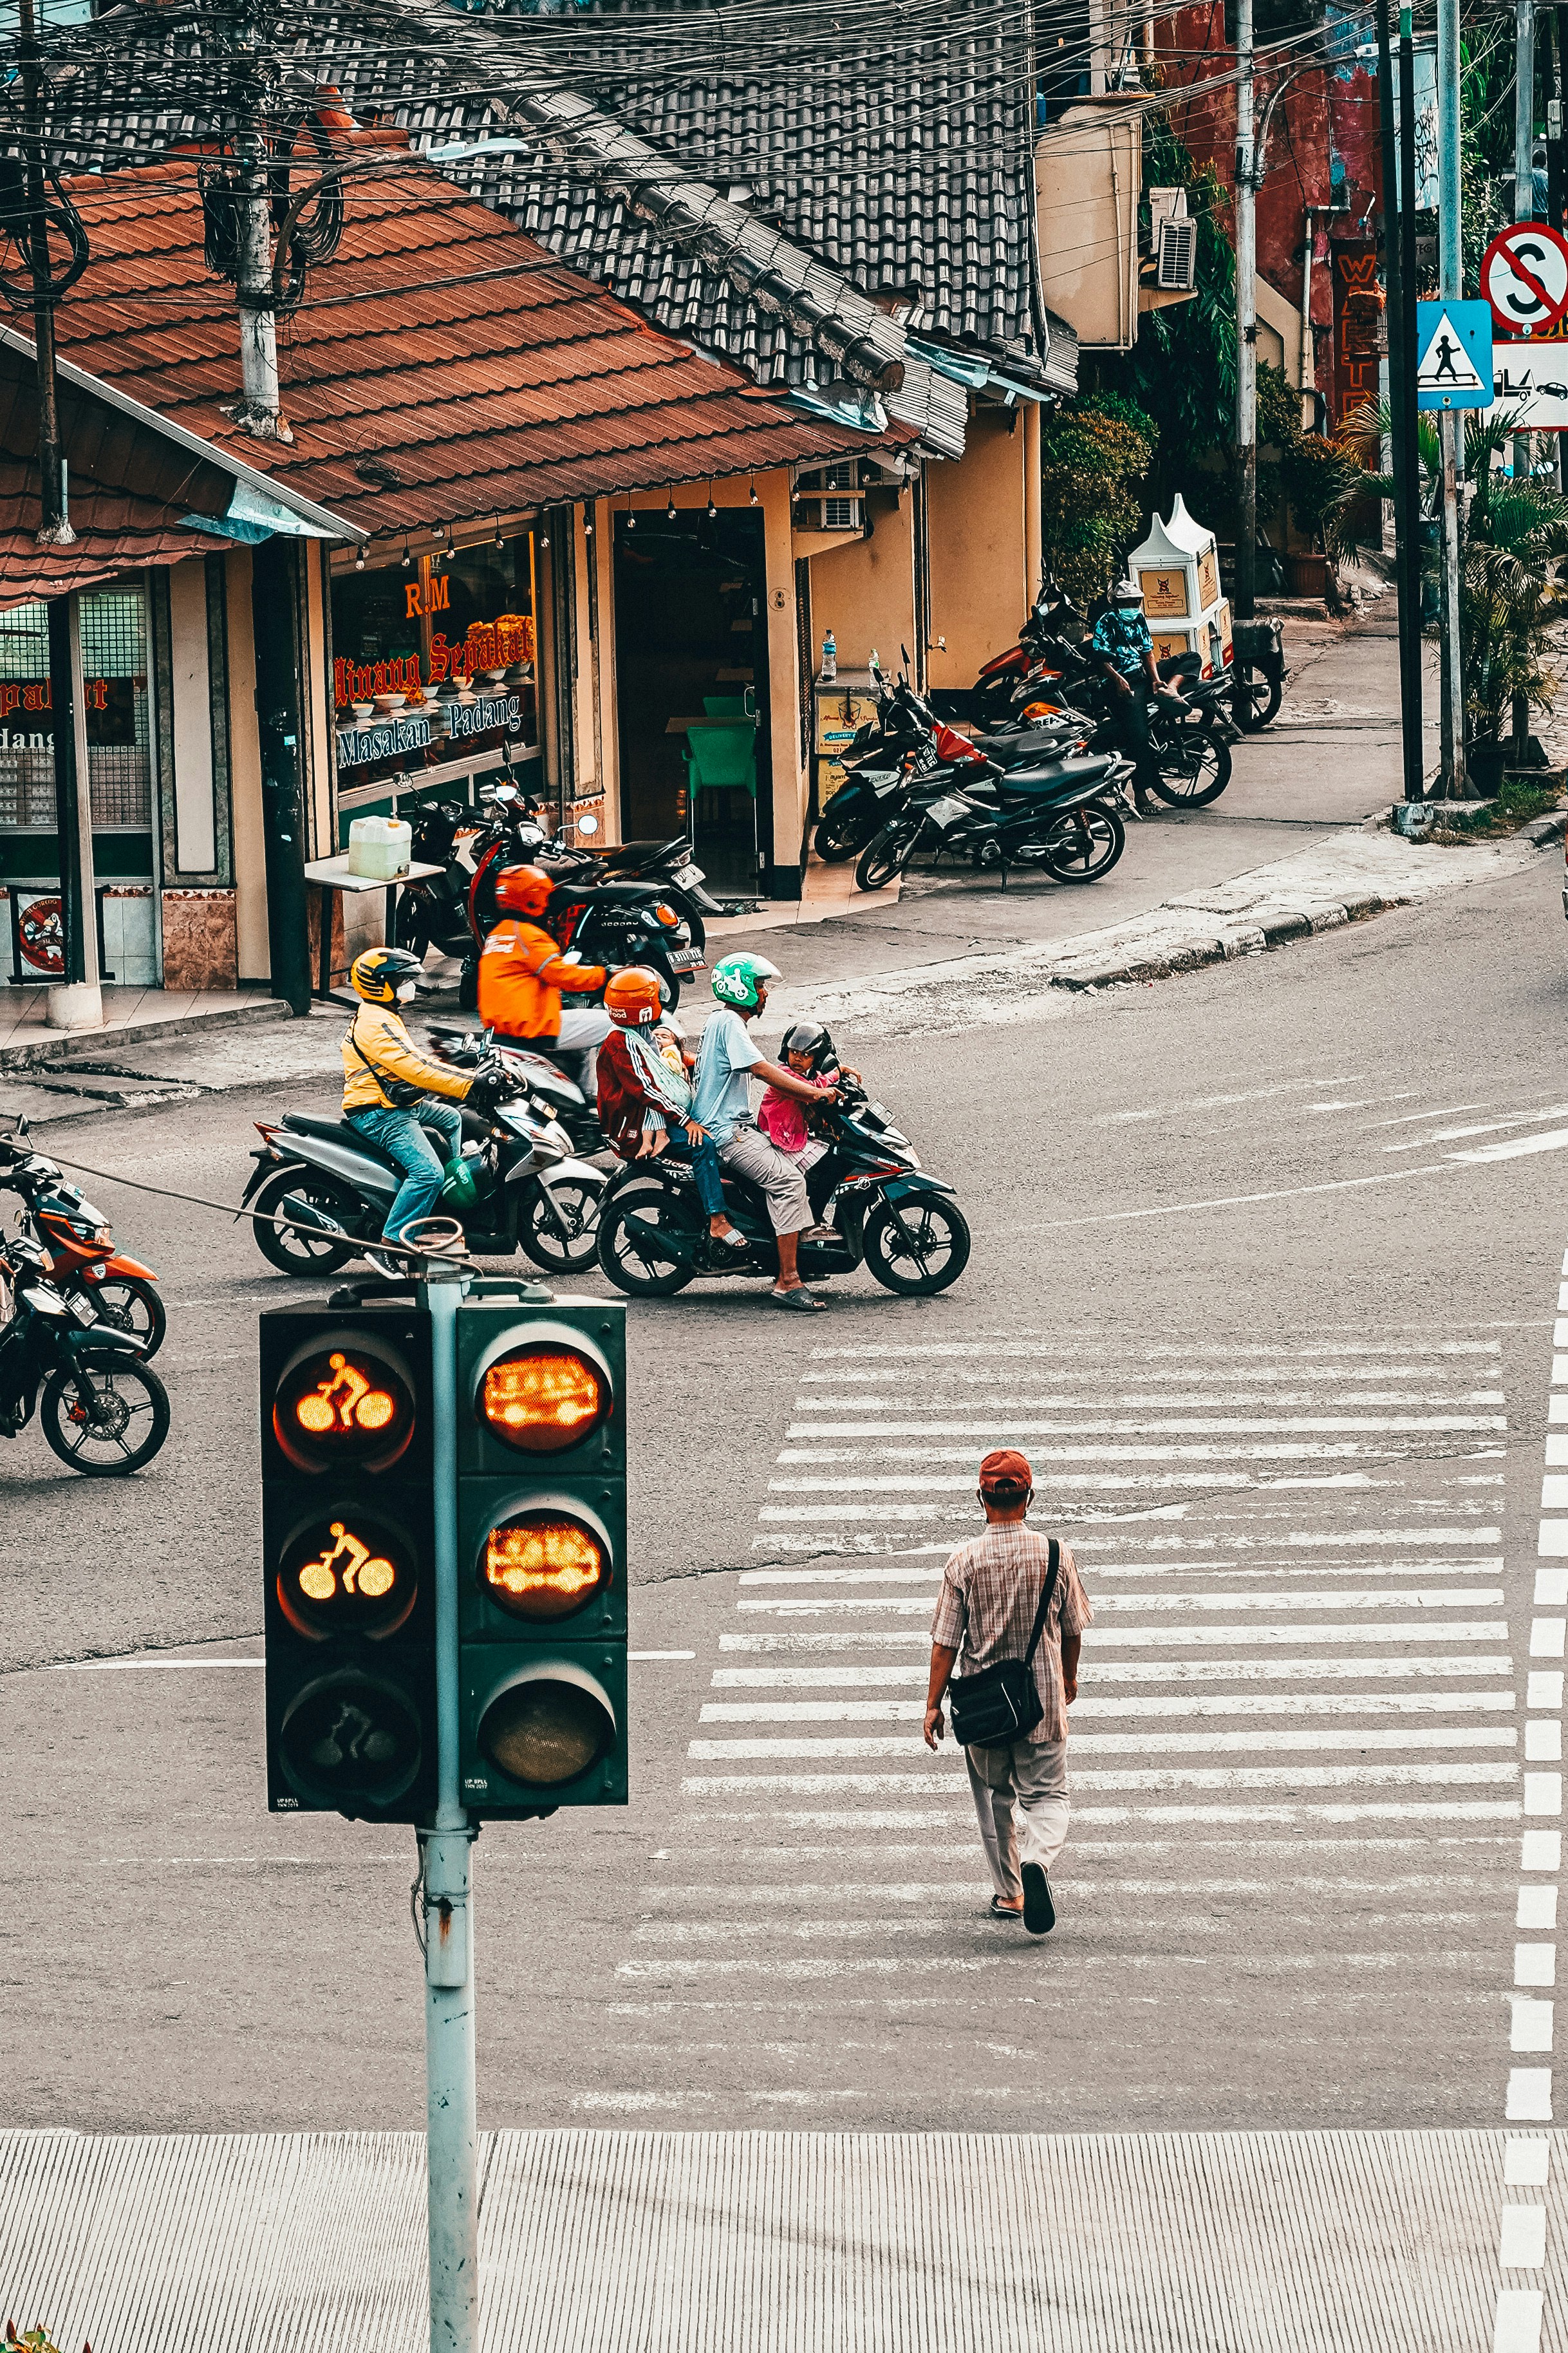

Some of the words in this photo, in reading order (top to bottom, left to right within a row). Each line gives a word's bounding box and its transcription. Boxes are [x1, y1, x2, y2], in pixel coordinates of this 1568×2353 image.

[427, 618, 534, 686] Sepakat
[339, 718, 432, 769] Masakan
[449, 696, 521, 740] Padang
